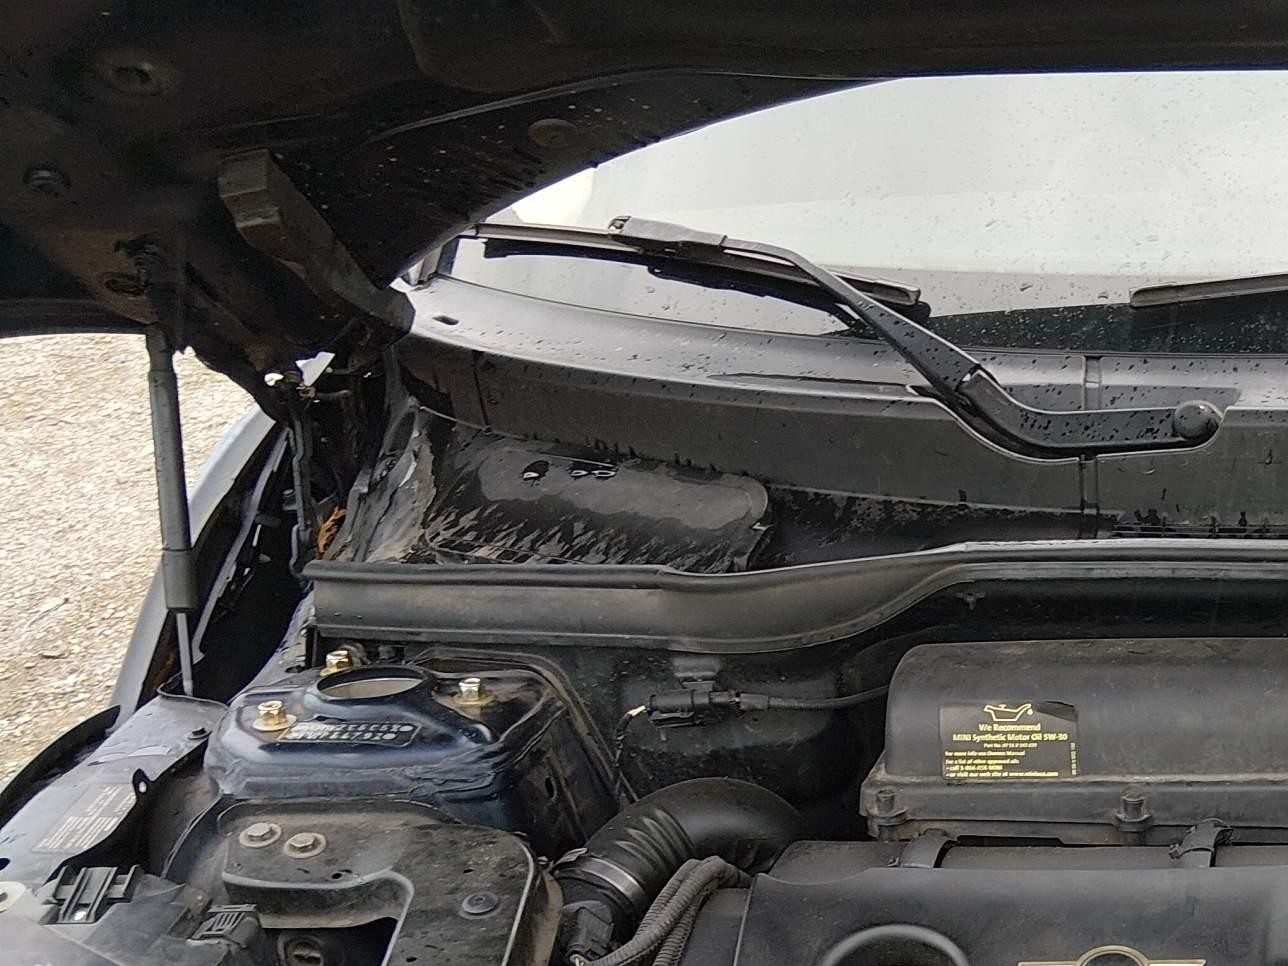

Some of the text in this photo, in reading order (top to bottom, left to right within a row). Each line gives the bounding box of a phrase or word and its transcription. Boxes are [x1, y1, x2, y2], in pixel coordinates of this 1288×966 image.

[993, 723, 1041, 732] Recommend
[972, 733, 1006, 743] Synthetic
[1007, 733, 1030, 741] Motor
[1031, 732, 1042, 741] Oil
